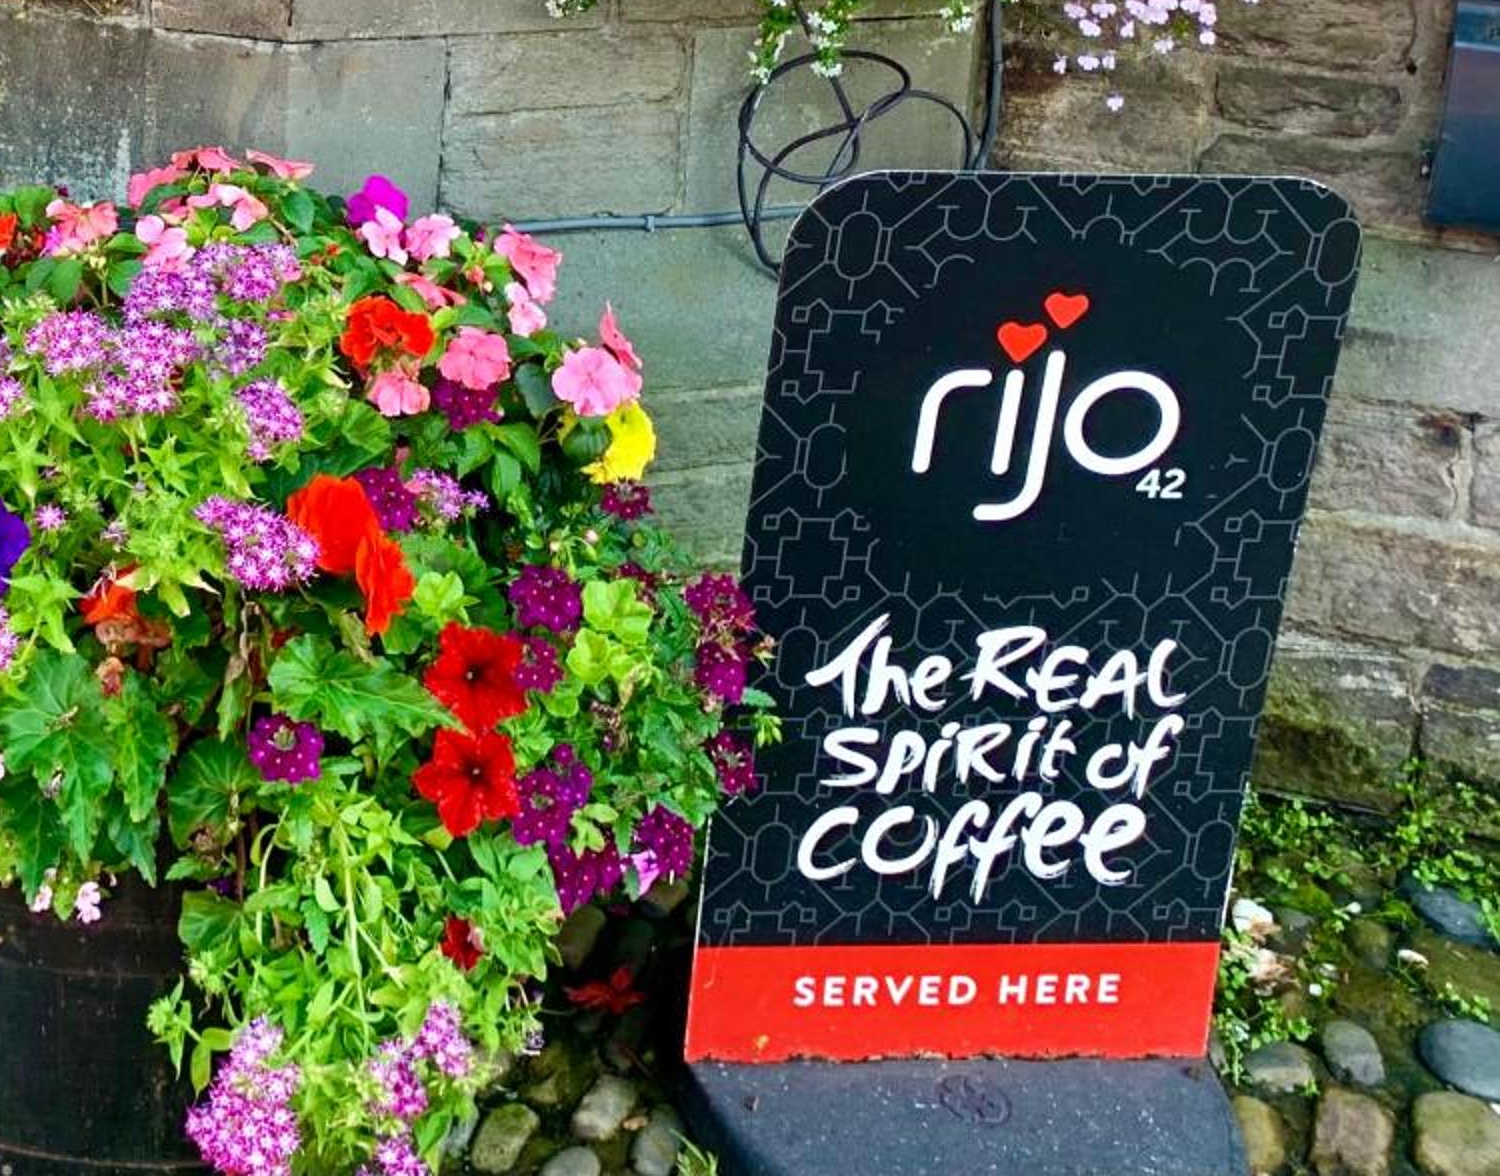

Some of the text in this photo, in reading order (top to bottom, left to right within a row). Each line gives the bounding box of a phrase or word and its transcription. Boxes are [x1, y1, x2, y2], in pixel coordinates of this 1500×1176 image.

[910, 346, 1182, 523] rijo
[1135, 467, 1187, 500] 42
[804, 612, 1188, 720] The REAL
[1084, 712, 1186, 801] of
[792, 973, 1122, 1007] SERVED HERE
